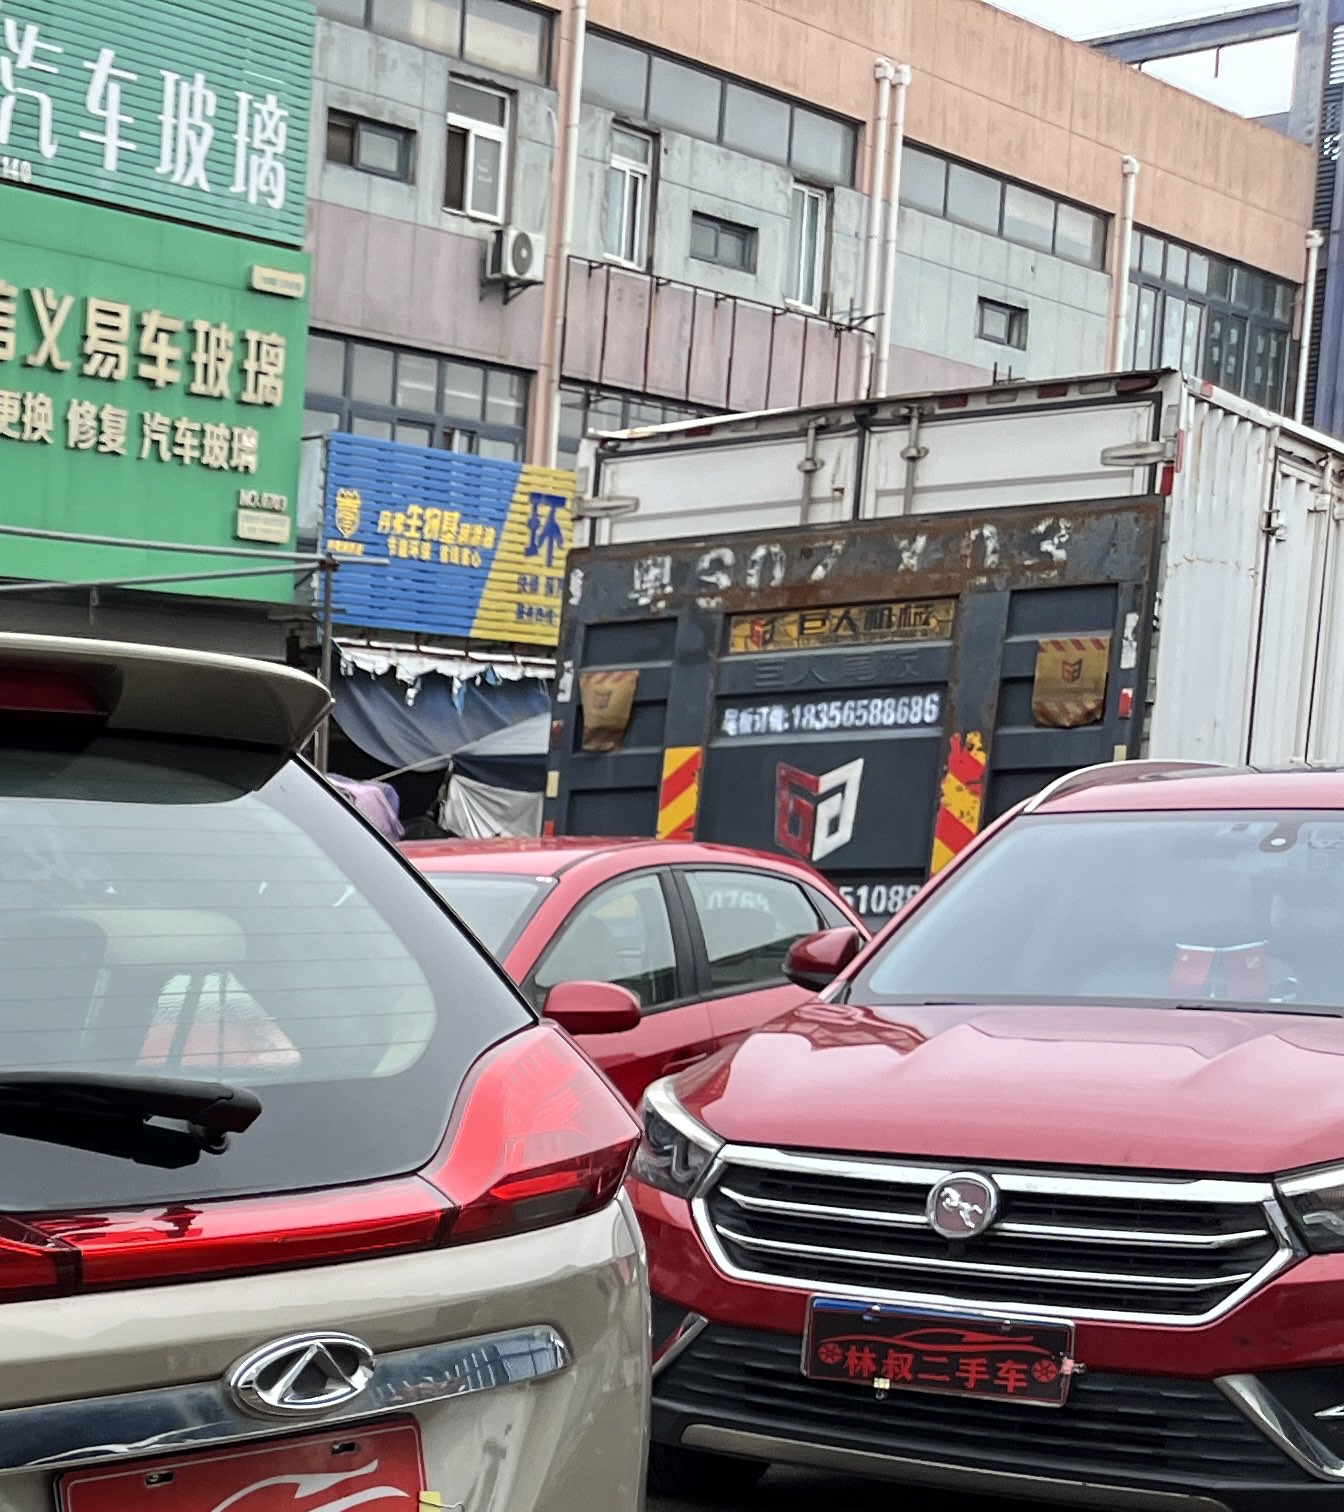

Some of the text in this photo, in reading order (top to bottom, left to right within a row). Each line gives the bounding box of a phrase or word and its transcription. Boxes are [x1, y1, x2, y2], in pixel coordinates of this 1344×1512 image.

[67, 398, 128, 455] 修复
[140, 412, 258, 473] 汽车玻璃
[843, 1344, 1028, 1393] 林叔二手车
